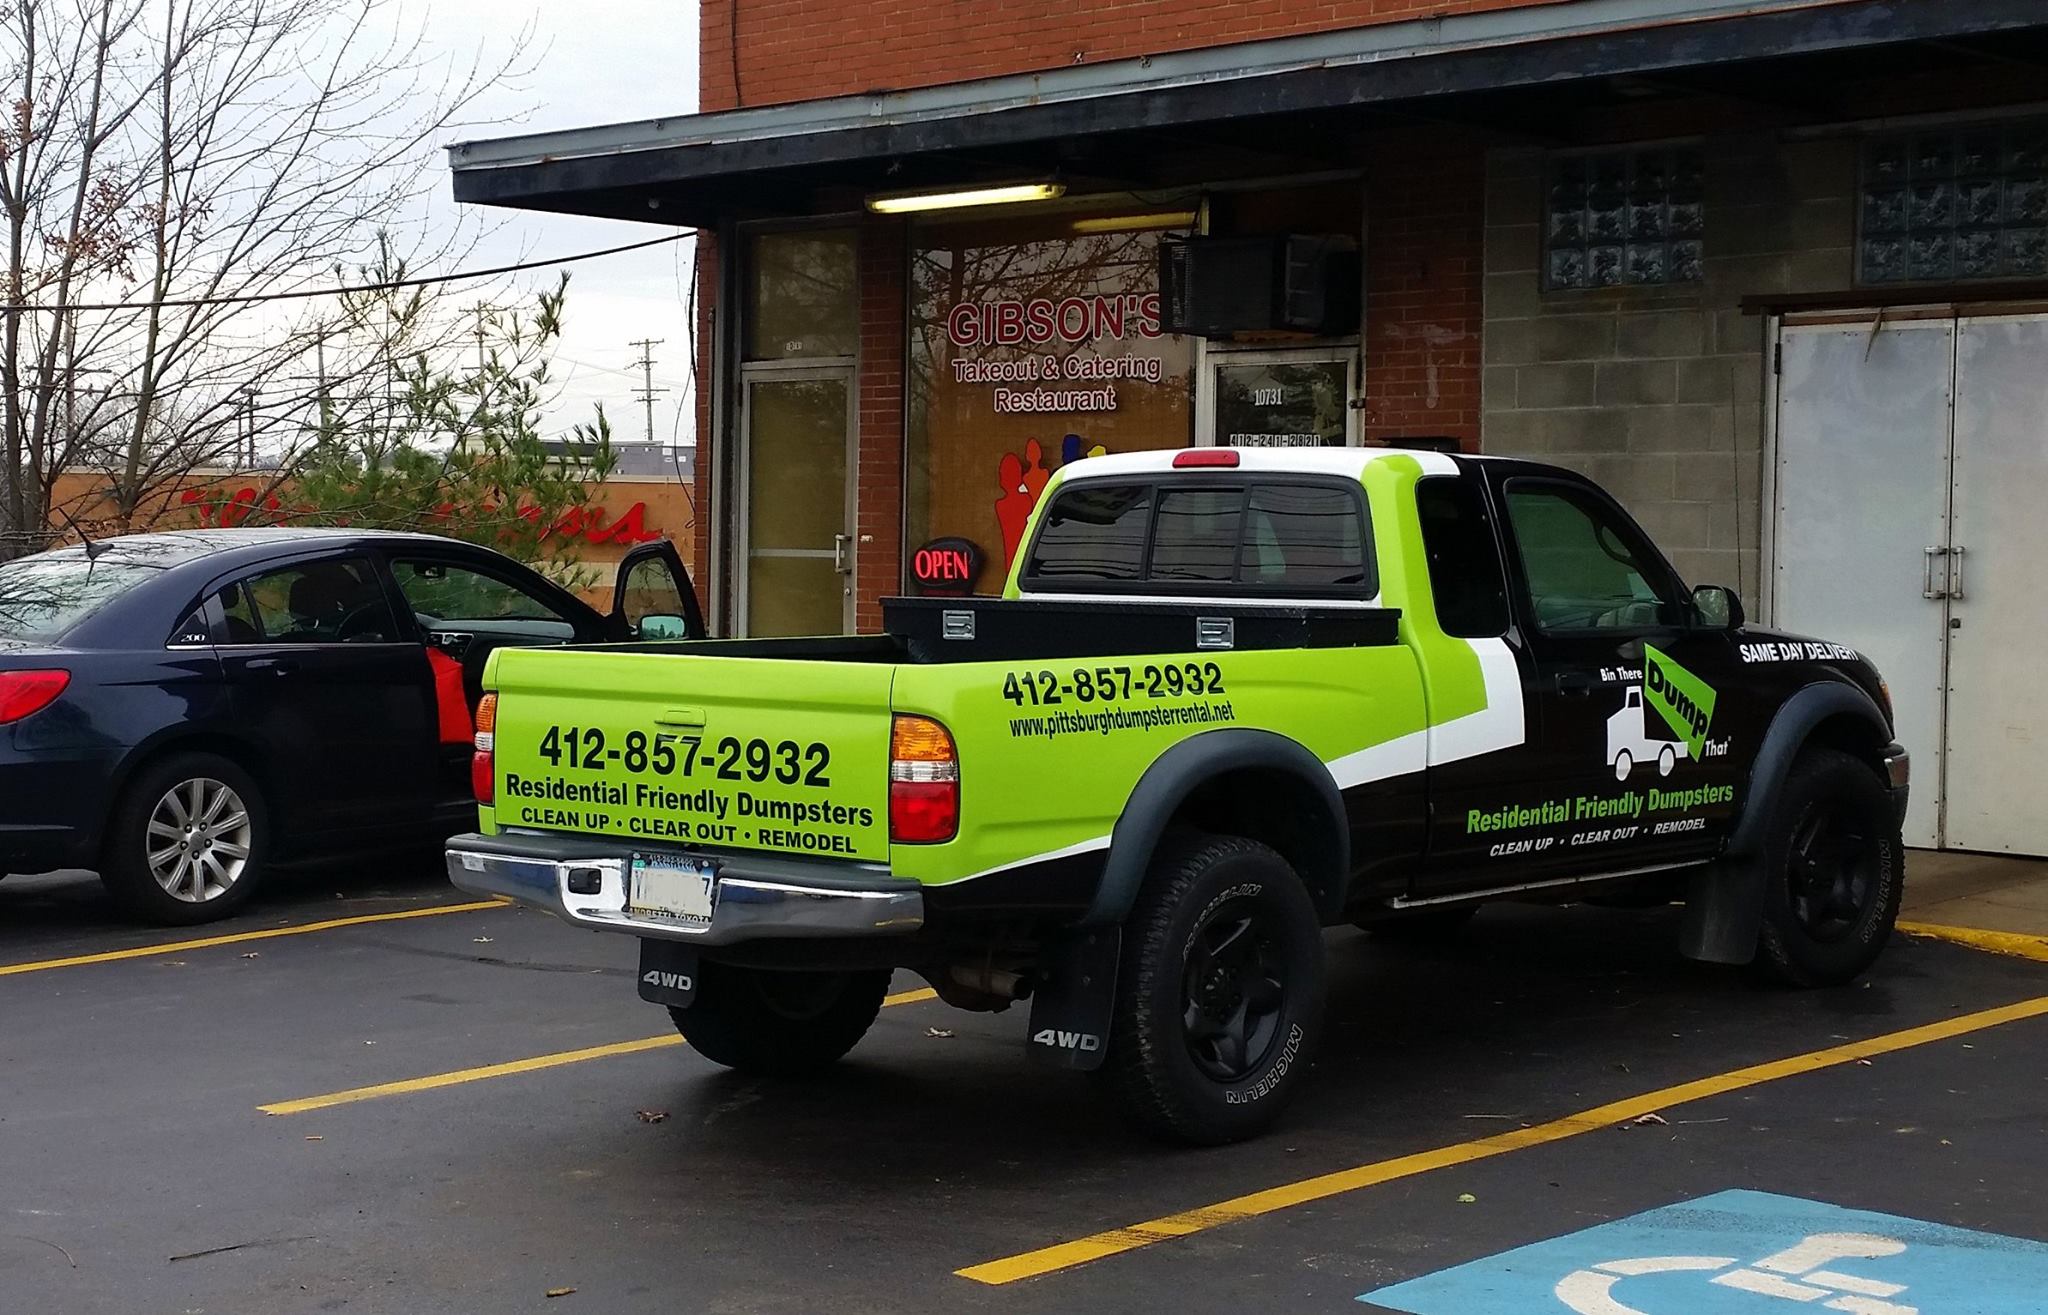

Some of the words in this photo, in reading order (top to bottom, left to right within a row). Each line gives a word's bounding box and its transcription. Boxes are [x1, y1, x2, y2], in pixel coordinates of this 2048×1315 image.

[948, 294, 1163, 346] GIBSON'S
[952, 357, 1038, 383] Takeout
[1042, 356, 1060, 380] &
[1064, 354, 1161, 382] Catering
[994, 386, 1116, 412] Restaurant
[1254, 388, 1282, 406] 10731
[915, 550, 969, 579] OPEN
[181, 634, 206, 642] 200
[1739, 643, 1779, 663] SAME
[1778, 643, 1804, 661] DAY
[1002, 662, 1225, 706] 412-857-2932
[1600, 668, 1616, 682] Bin
[1616, 666, 1643, 681] There
[1647, 658, 1708, 739] Dump
[1009, 701, 1235, 739] www.pittsburghdumpsterrental.net
[539, 725, 831, 788] 412-857-2932
[1705, 739, 1729, 757] That
[505, 773, 628, 806] Residential
[636, 783, 728, 820] Friendly
[737, 791, 873, 827] Dumpsters
[1467, 799, 1570, 833] Residential
[1575, 792, 1643, 819] Friendly
[1648, 784, 1733, 811] Dumpsters
[521, 807, 579, 828] CLEAN
[585, 812, 609, 829] UP
[629, 818, 690, 837] CLEAR
[696, 822, 737, 842] OUT
[758, 829, 857, 853] REMODEL
[1490, 840, 1531, 857] CLEAN
[1534, 837, 1553, 851] UP
[1571, 830, 1611, 846] CLEAR
[1613, 827, 1638, 840] OUT
[1653, 818, 1706, 834] REMODEL
[675, 913, 710, 924] TOYOTA
[643, 970, 692, 991] 4WD
[1033, 1029, 1099, 1051] 4WD
[1225, 1023, 1304, 1105] MICHELIN
